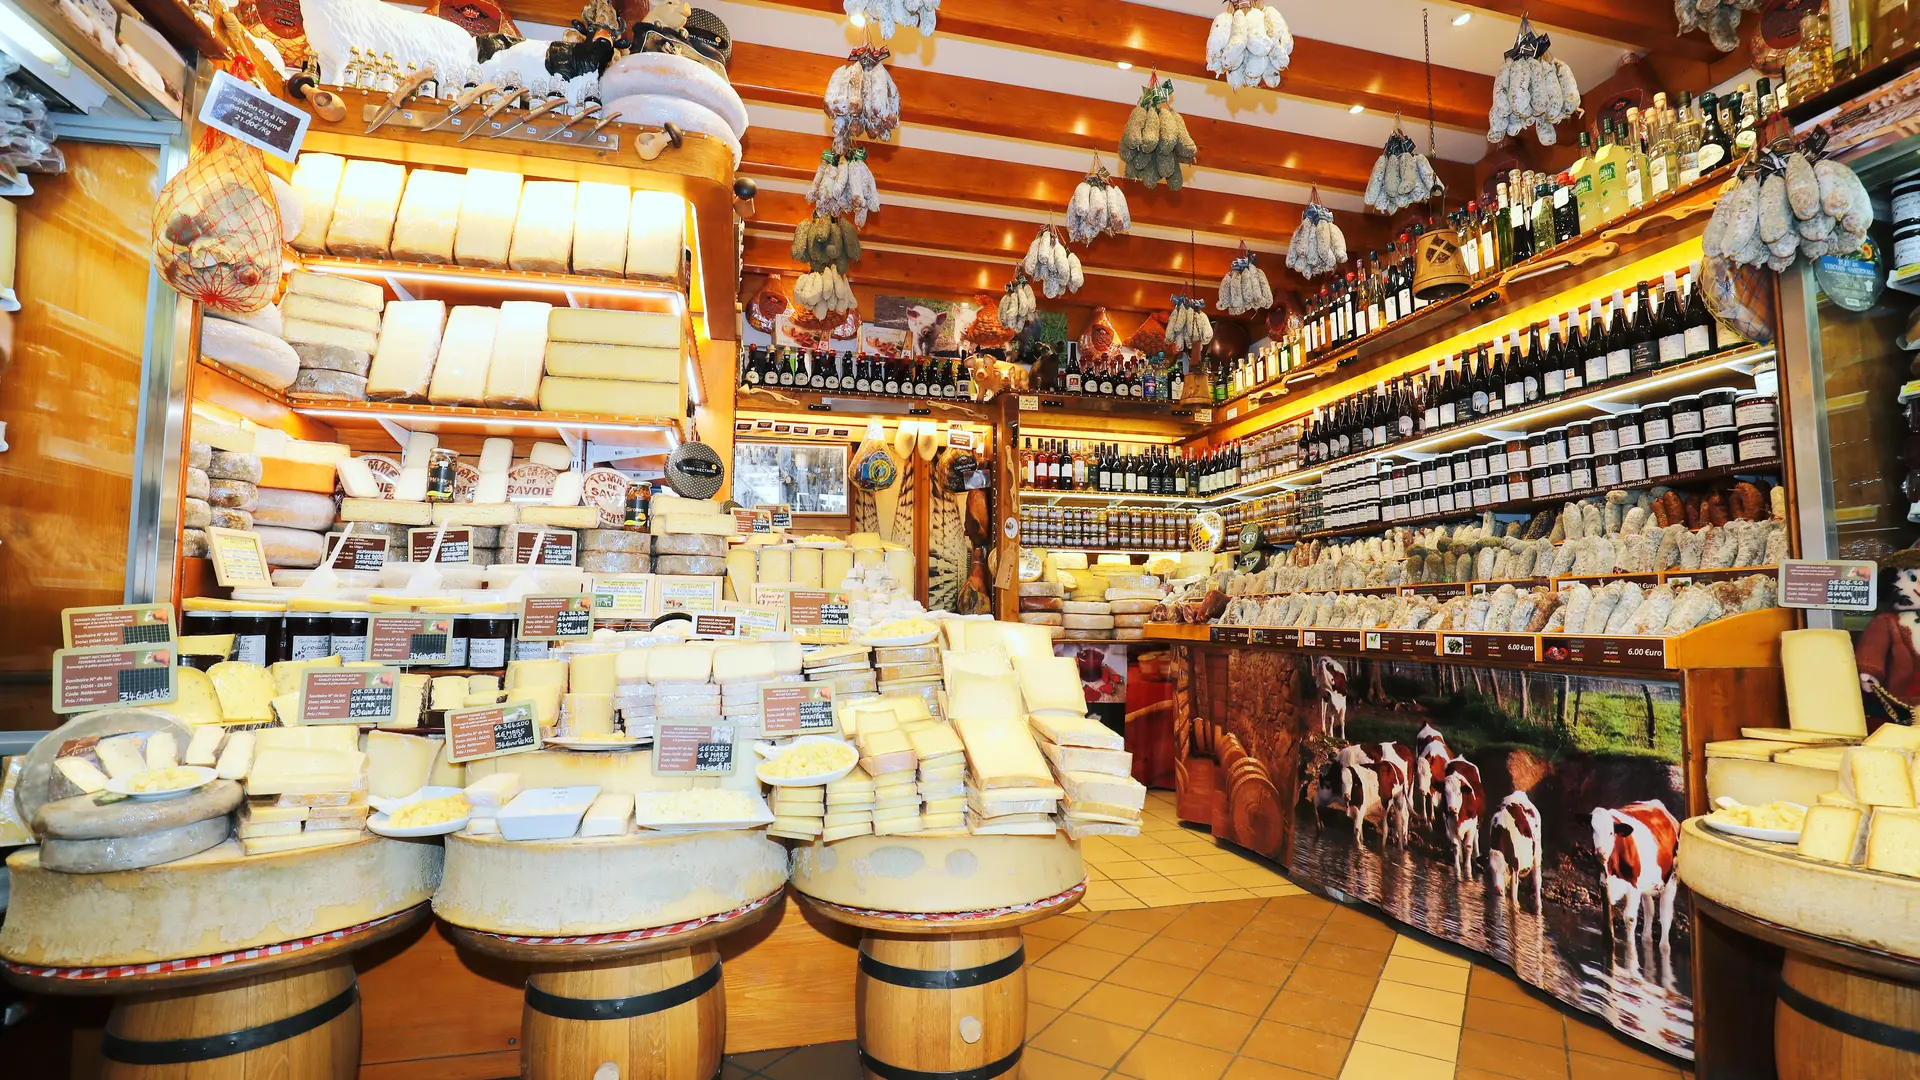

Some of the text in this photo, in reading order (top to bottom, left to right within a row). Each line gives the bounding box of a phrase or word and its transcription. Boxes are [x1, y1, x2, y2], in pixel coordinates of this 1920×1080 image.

[229, 93, 258, 111] Jambon
[258, 109, 270, 117] cru
[276, 116, 288, 126] l'os
[230, 104, 253, 117] nature
[264, 119, 282, 131] fumé
[508, 485, 553, 496] SAVOIE
[592, 488, 621, 500] SAVO
[1520, 644, 1534, 652] €uro
[1627, 648, 1643, 656] 6.00
[120, 692, 136, 702] 34
[160, 688, 169, 698] KG
[381, 706, 390, 714] KG
